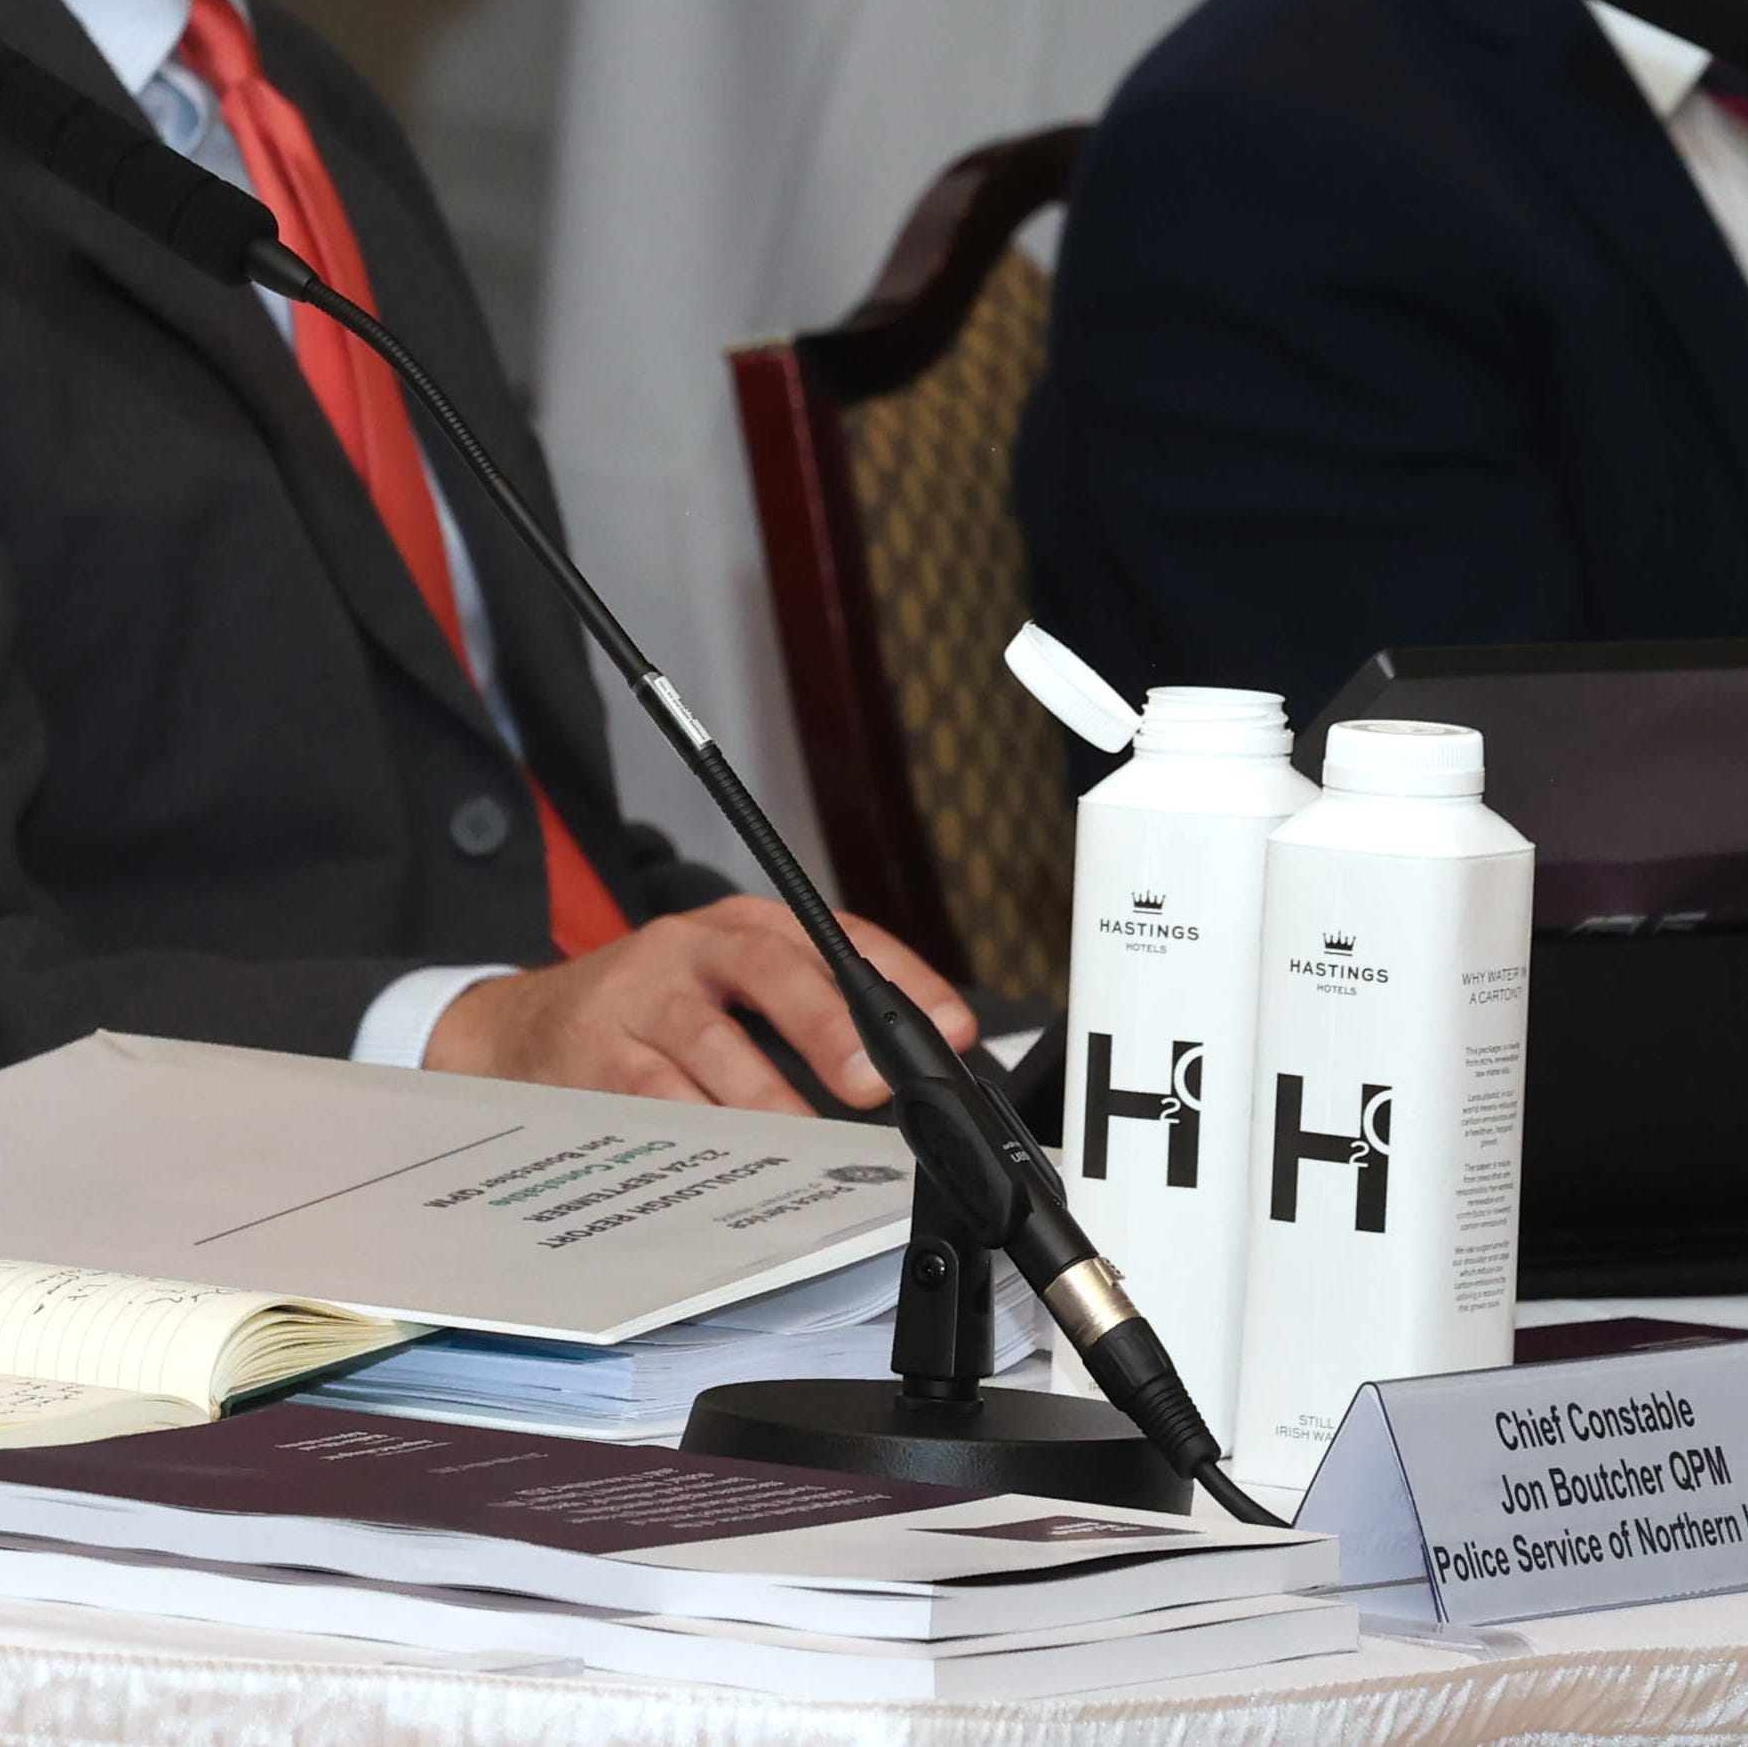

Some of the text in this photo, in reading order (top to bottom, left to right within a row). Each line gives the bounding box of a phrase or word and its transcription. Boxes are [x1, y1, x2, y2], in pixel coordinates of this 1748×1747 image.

[1099, 918, 1200, 942] HASTINGS
[1125, 942, 1168, 955] HOTELS
[1290, 958, 1390, 984] HASTINGS
[1461, 971, 1486, 986] WHY
[1487, 967, 1520, 984] WATER
[1316, 983, 1358, 997] HOTELS
[1468, 992, 1477, 1005] A
[522, 1170, 669, 1224] SEPTEMBER
[638, 1155, 791, 1216] McCULLOUGH
[537, 1207, 635, 1250] REPORT
[1275, 1424, 1311, 1440] IRISH
[1298, 1413, 1335, 1430] STILL
[1495, 1390, 1696, 1452] Chief Constable
[1500, 1445, 1733, 1516] Jon Boutcher QPM
[1432, 1536, 1511, 1585] Police
[1512, 1527, 1604, 1573] Service
[1608, 1520, 1635, 1560] of
[1634, 1503, 1743, 1556] Northern
